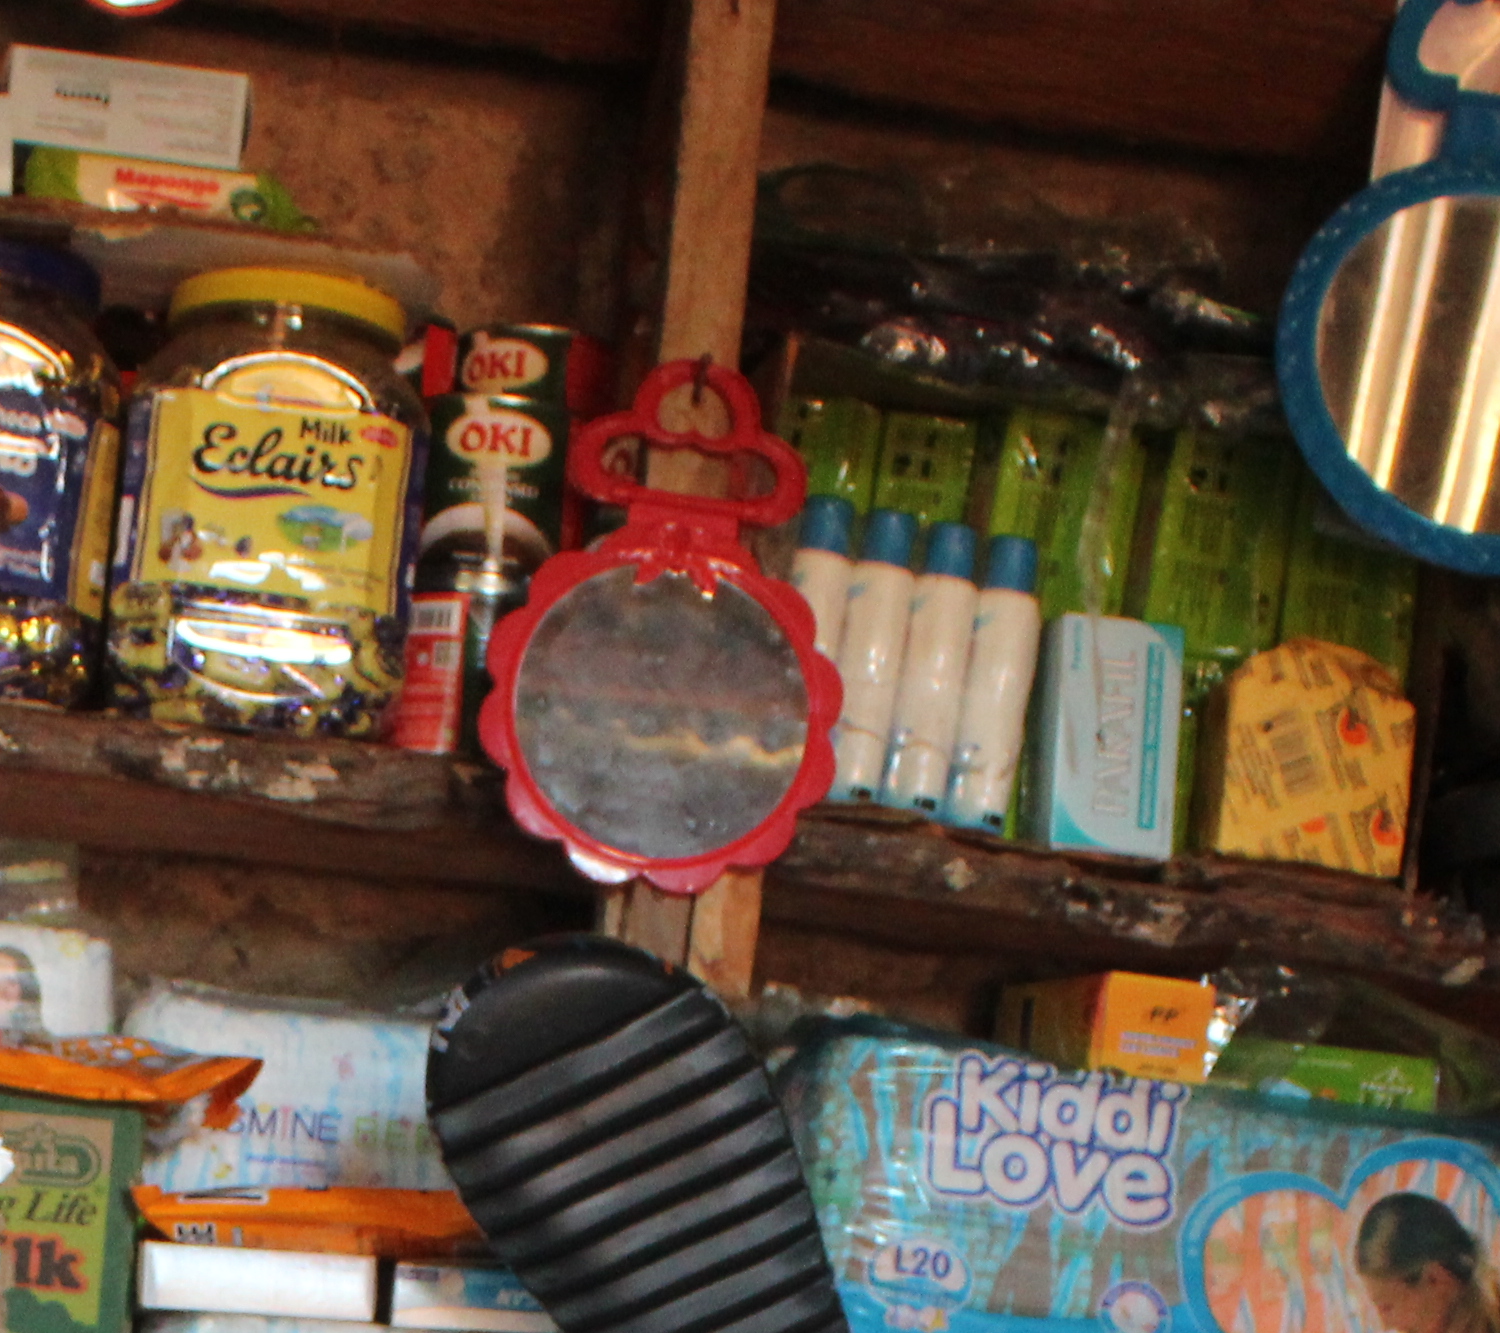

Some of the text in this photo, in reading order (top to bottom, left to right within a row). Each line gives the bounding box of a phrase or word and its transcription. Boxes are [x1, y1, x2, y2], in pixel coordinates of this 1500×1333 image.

[467, 349, 527, 382] OKI
[300, 417, 351, 445] Milk
[459, 422, 534, 457] OKI
[193, 421, 364, 490] Eclairs
[960, 1058, 1190, 1157] Kiddi
[929, 1093, 1177, 1227] Love
[26, 1189, 98, 1226] Life
[893, 1247, 951, 1281] L20
